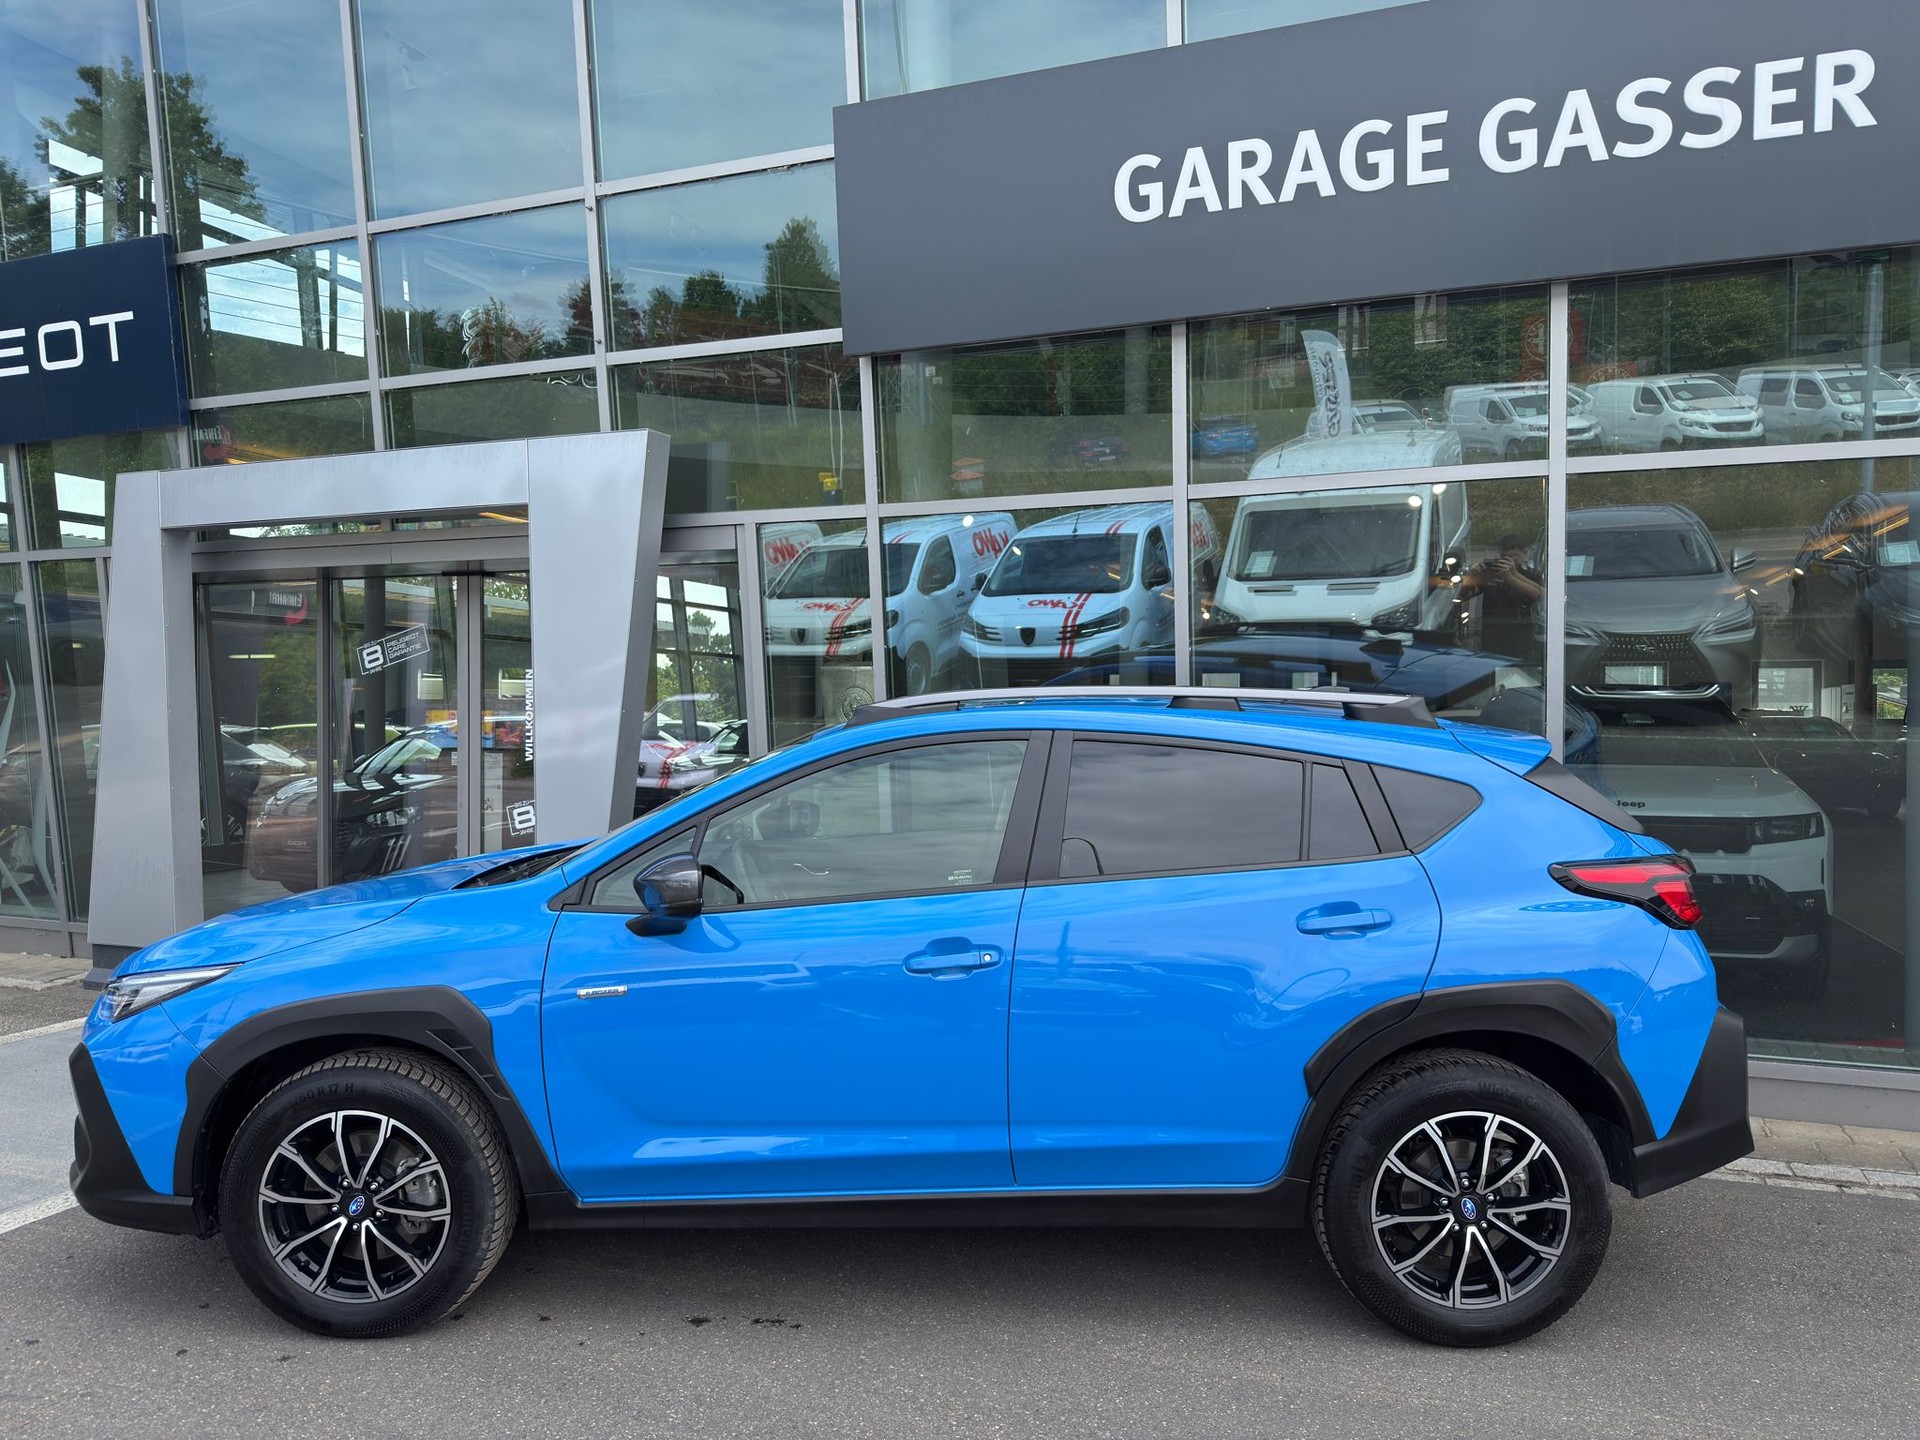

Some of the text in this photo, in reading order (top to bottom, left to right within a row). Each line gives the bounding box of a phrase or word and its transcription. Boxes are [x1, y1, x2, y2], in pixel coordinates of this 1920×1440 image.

[1114, 49, 1878, 223] GARAGE GASSER
[0, 310, 134, 377] EOT
[387, 632, 420, 648] PEUGEOT
[387, 643, 407, 654] CARE
[363, 644, 384, 669] 8
[389, 643, 422, 659] GARANTIE
[369, 665, 383, 675] JAHRE
[525, 669, 534, 761] WILLKOMMEN
[1616, 800, 1646, 809] Jeep
[513, 805, 536, 830] 8
